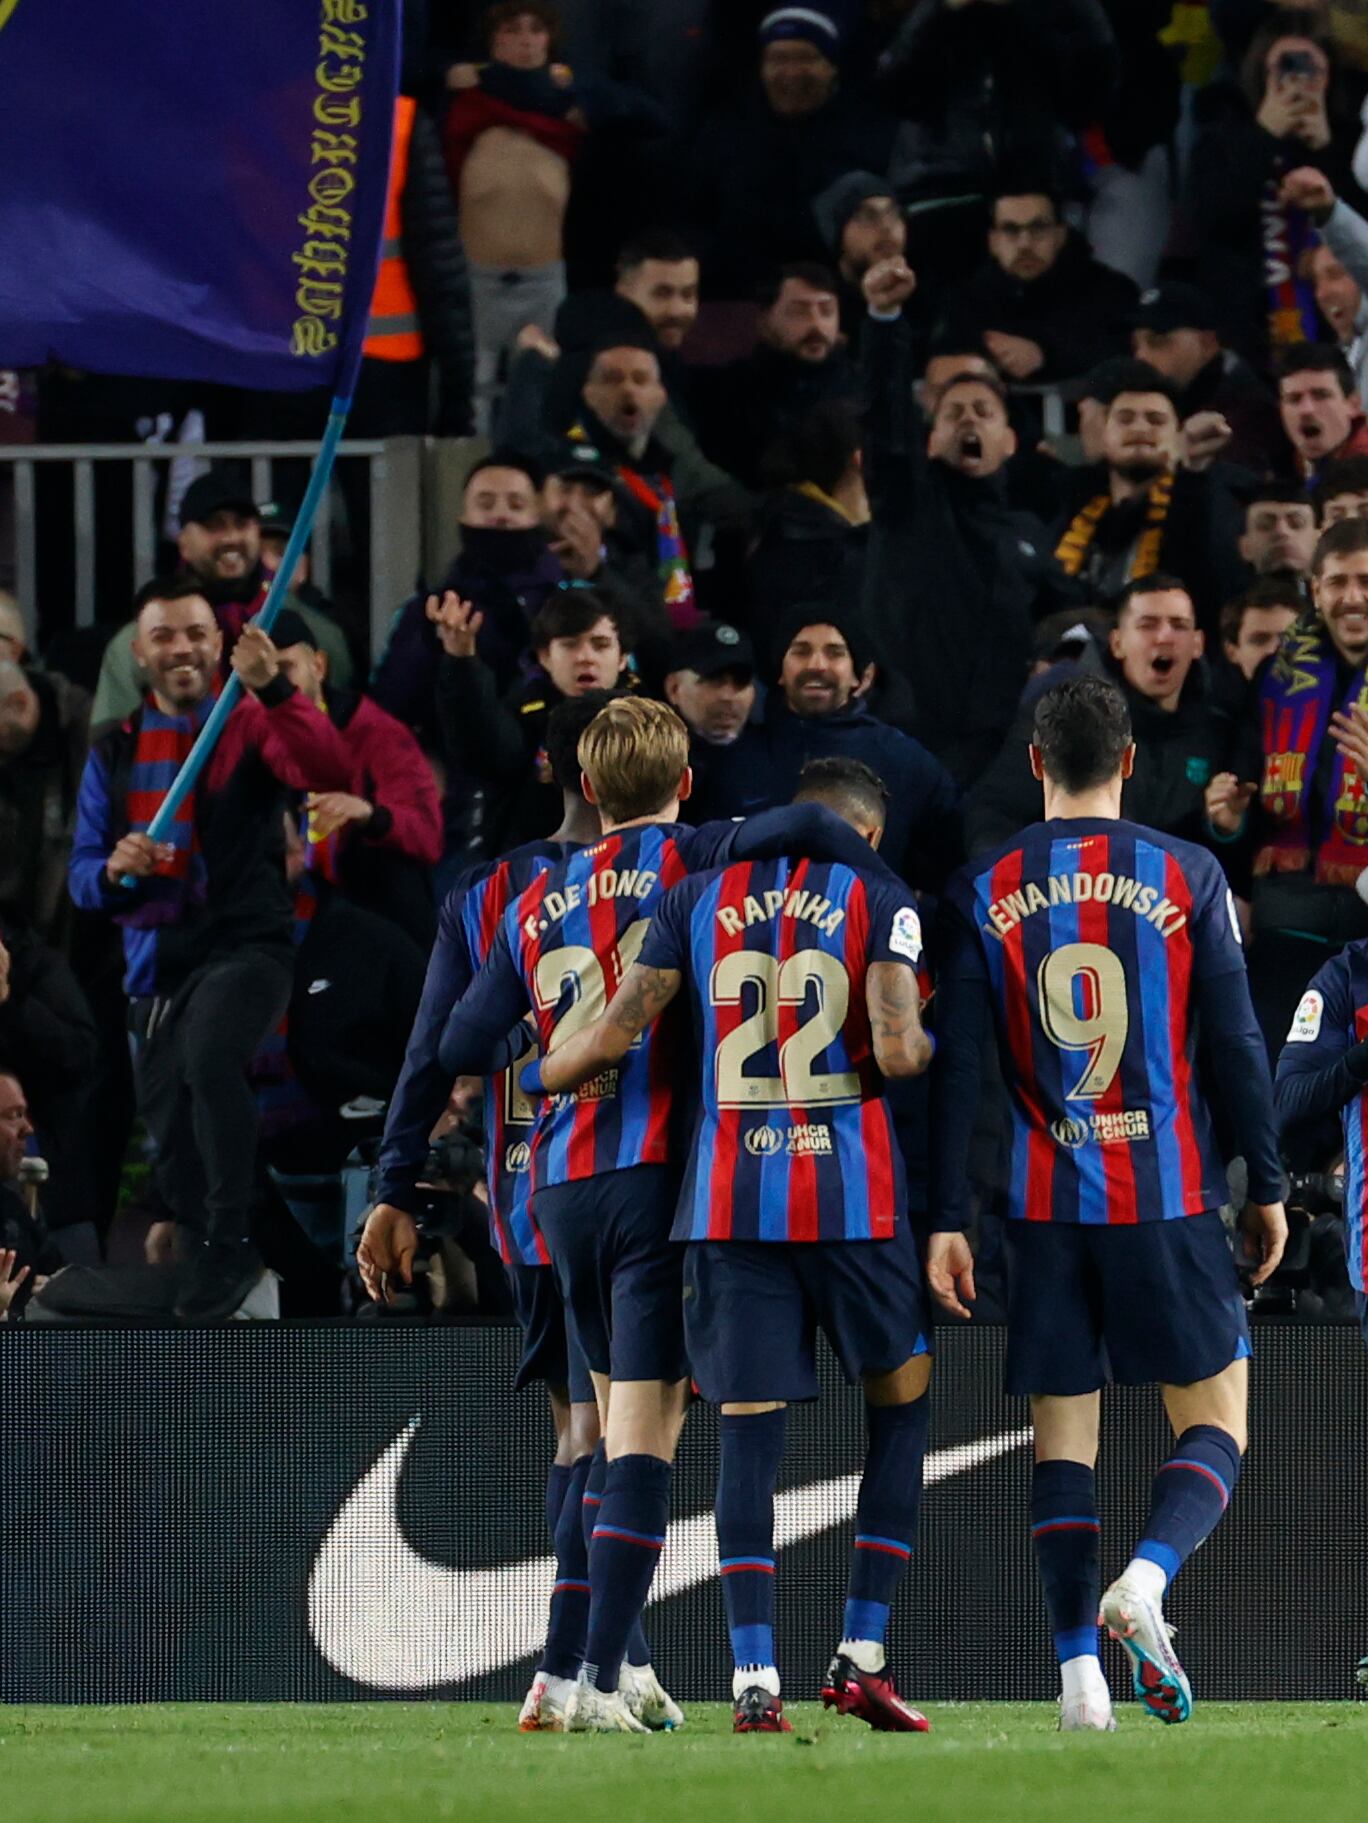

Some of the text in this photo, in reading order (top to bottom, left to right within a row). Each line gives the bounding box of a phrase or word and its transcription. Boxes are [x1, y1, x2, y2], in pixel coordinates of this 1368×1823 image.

[543, 884, 581, 921] DE
[588, 869, 657, 907] JONG
[709, 949, 862, 1109] 22
[1037, 942, 1129, 1100] 9
[1089, 1110, 1147, 1127] UNHCR
[1092, 1122, 1149, 1140] ACNUR
